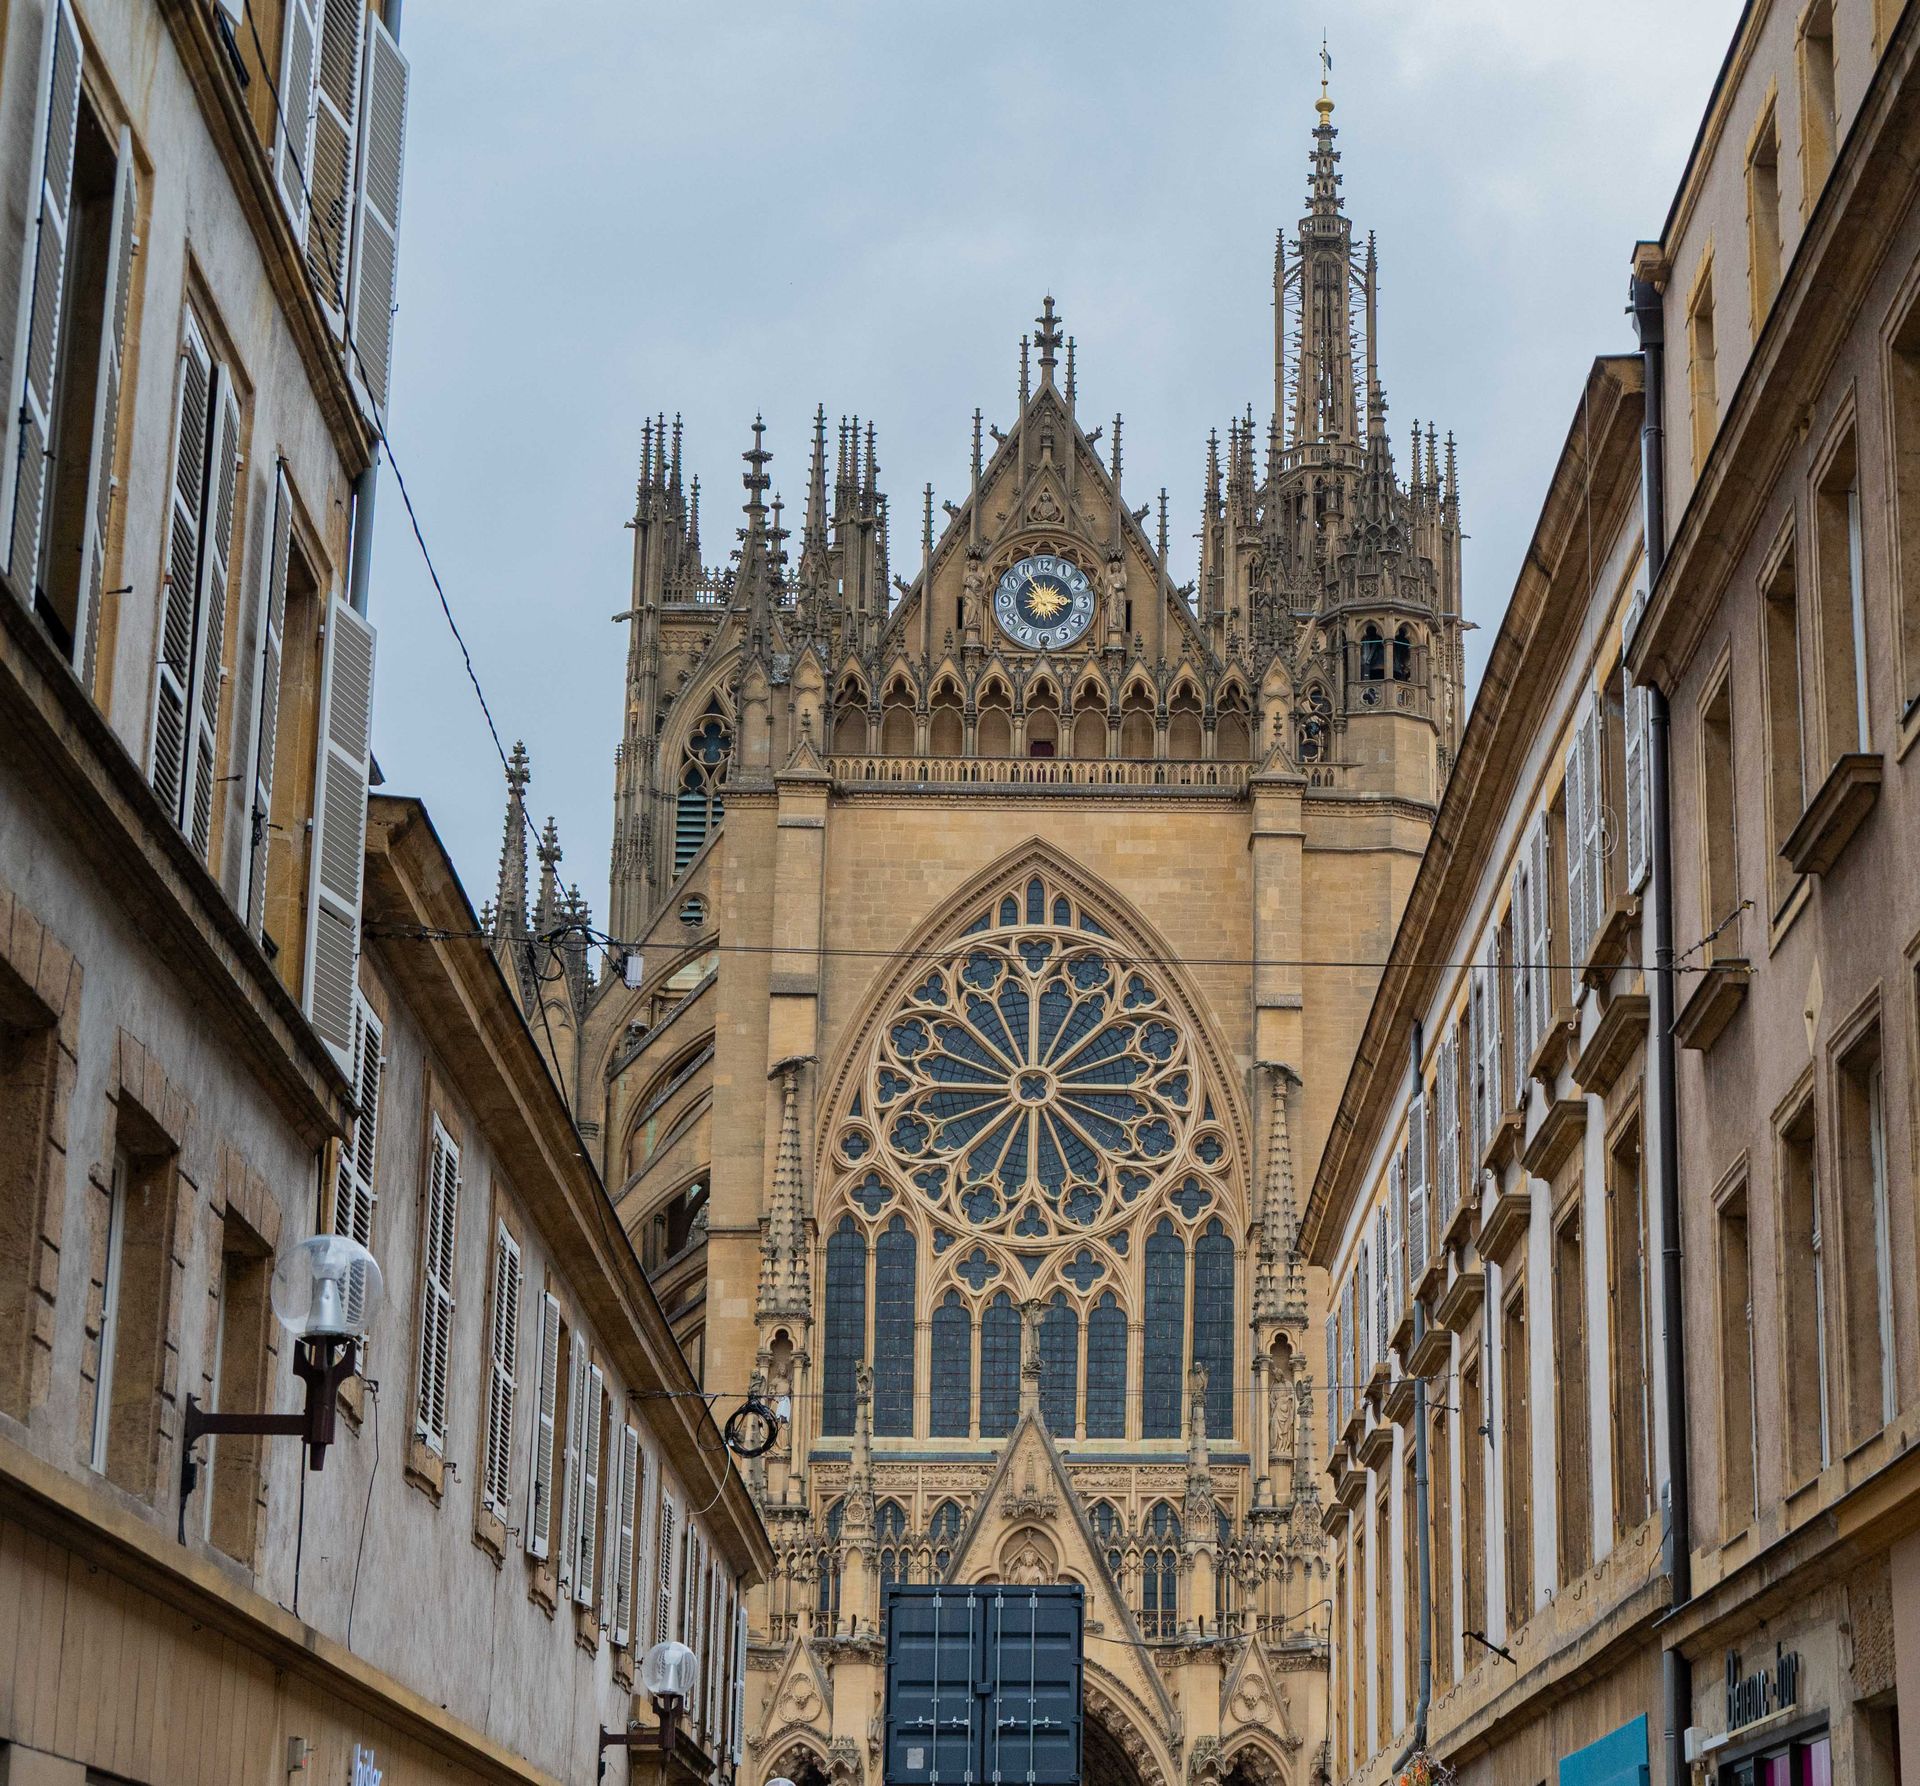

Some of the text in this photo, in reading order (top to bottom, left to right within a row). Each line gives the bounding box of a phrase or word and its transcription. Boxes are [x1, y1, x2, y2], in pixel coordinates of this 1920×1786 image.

[1040, 560, 1051, 571] 12
[1062, 565, 1067, 576] 1
[1007, 577, 1018, 589] 10
[1073, 579, 1083, 590] 2
[1000, 596, 1011, 607] 9
[1080, 597, 1089, 608] 3
[1006, 613, 1016, 625] 8
[1071, 615, 1083, 626] 4
[1019, 627, 1030, 639] 7
[1039, 632, 1050, 644] 6
[1060, 628, 1069, 640] 5
